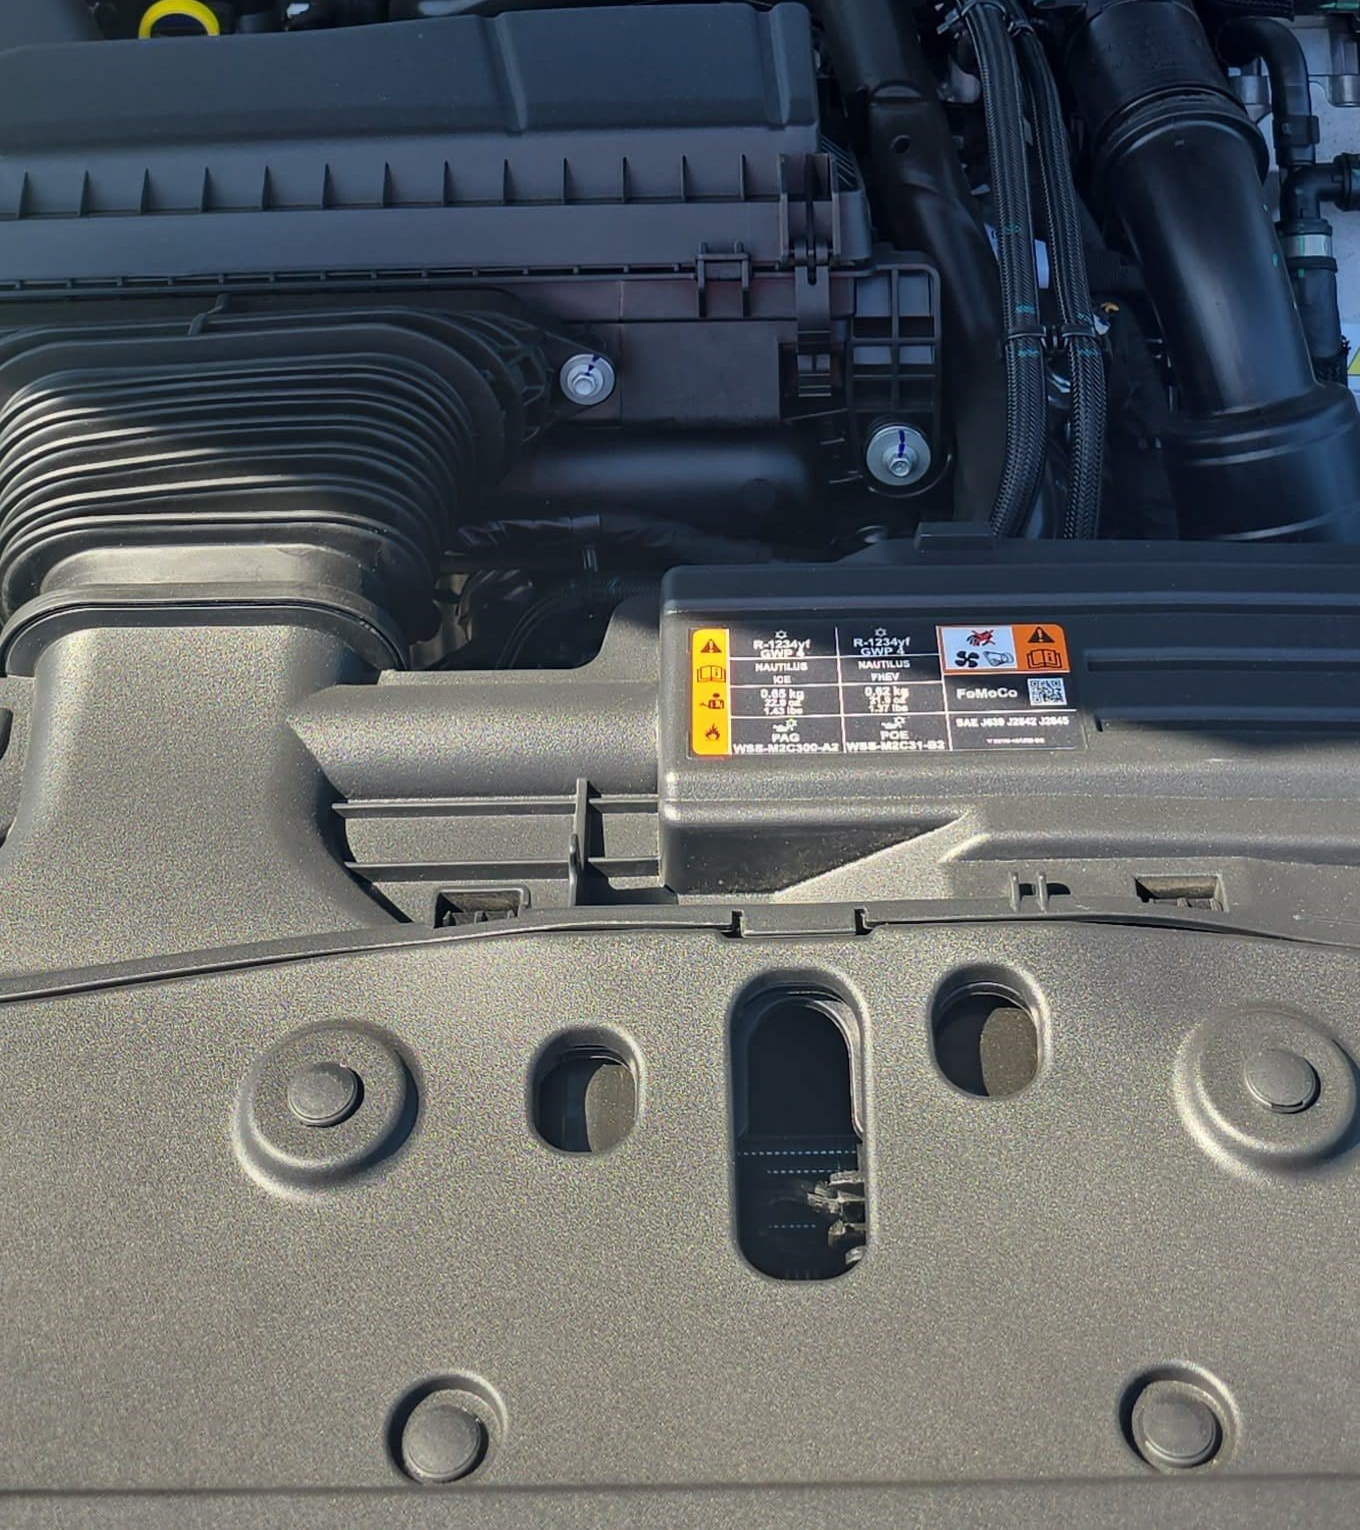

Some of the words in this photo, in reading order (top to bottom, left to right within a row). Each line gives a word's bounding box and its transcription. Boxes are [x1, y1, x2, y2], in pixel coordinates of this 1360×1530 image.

[753, 639, 811, 651] R-1234yf
[854, 637, 911, 648] R-1234yf
[761, 649, 795, 658] GWP
[797, 648, 806, 658] 4
[860, 647, 893, 656] GWP
[896, 646, 905, 655] 4
[755, 662, 808, 671] NAUTILUS
[858, 660, 910, 669] NAUTILUS
[773, 676, 791, 684] ICE
[760, 689, 786, 698] 0.65
[789, 689, 804, 700] kg
[893, 686, 909, 698] kg
[956, 688, 1018, 700] FoMoCo
[787, 706, 803, 715] lbs
[890, 704, 908, 712] lbs
[955, 718, 979, 727] SAE
[772, 733, 800, 742] PAG
[880, 731, 909, 740] POE
